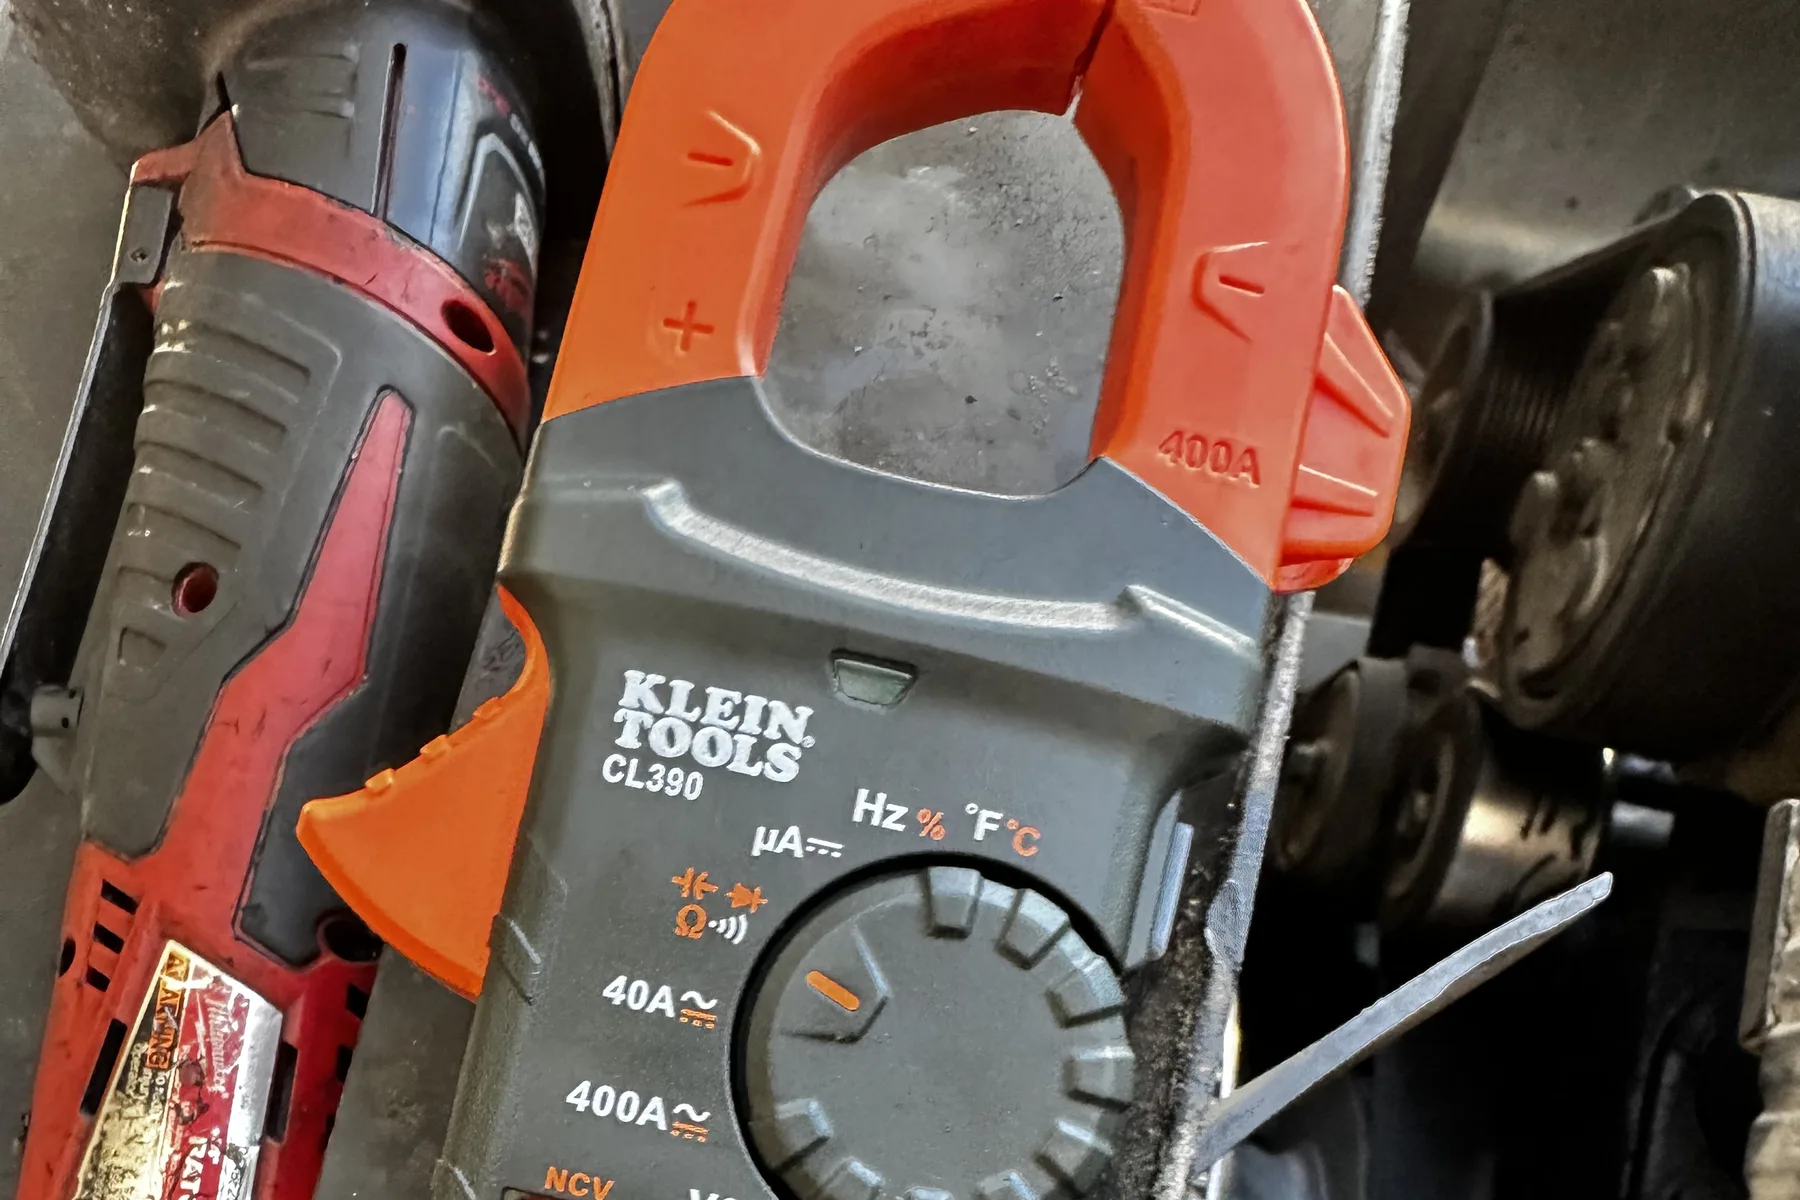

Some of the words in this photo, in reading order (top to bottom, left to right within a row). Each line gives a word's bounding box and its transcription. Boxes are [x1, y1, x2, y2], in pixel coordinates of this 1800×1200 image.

[1158, 429, 1261, 488] 400A
[618, 669, 815, 747] KLEIN
[613, 707, 803, 783] TOOLS
[602, 753, 704, 801] CL390
[852, 788, 909, 832] Hz
[602, 975, 677, 1018] 40A
[565, 1080, 669, 1131] 400A
